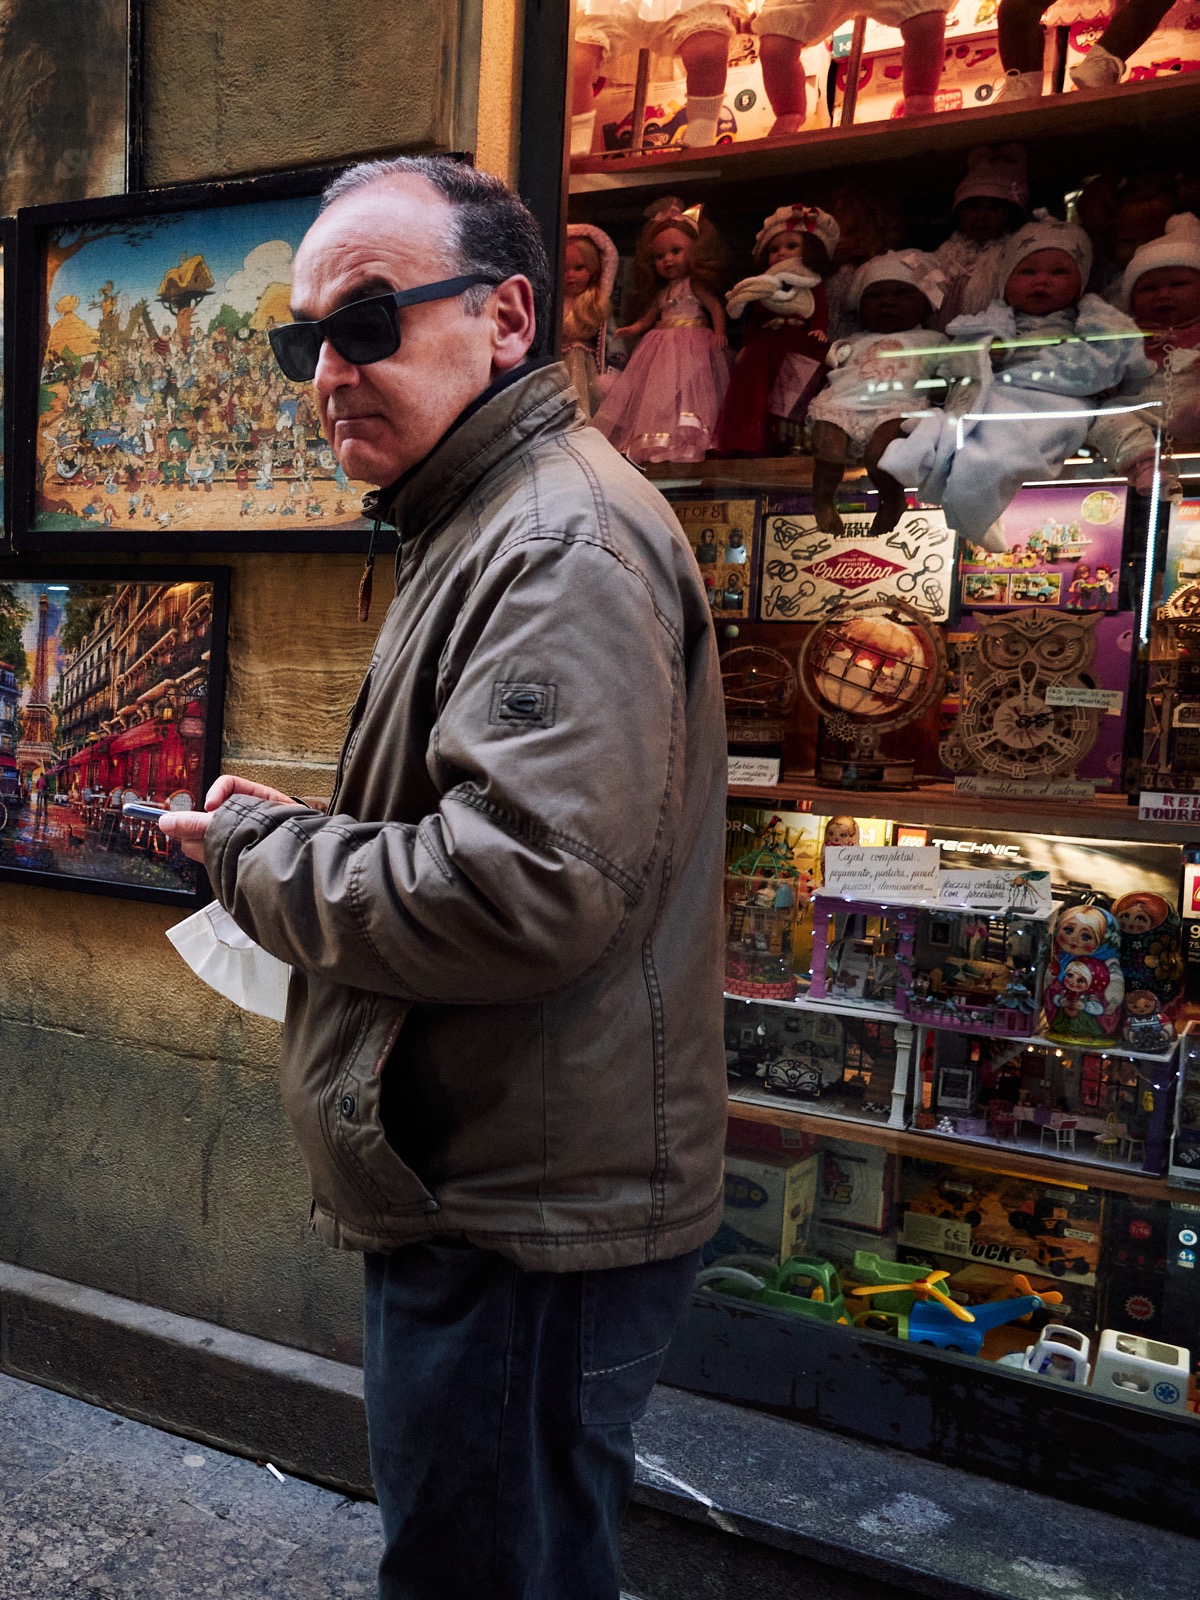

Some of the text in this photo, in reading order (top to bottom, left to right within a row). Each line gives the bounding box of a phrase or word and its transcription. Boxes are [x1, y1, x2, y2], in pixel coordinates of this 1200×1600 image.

[812, 561, 893, 580] Collection
[1039, 780, 1052, 794] el
[931, 838, 1020, 857] TECHNIC
[838, 848, 864, 868] Cajas
